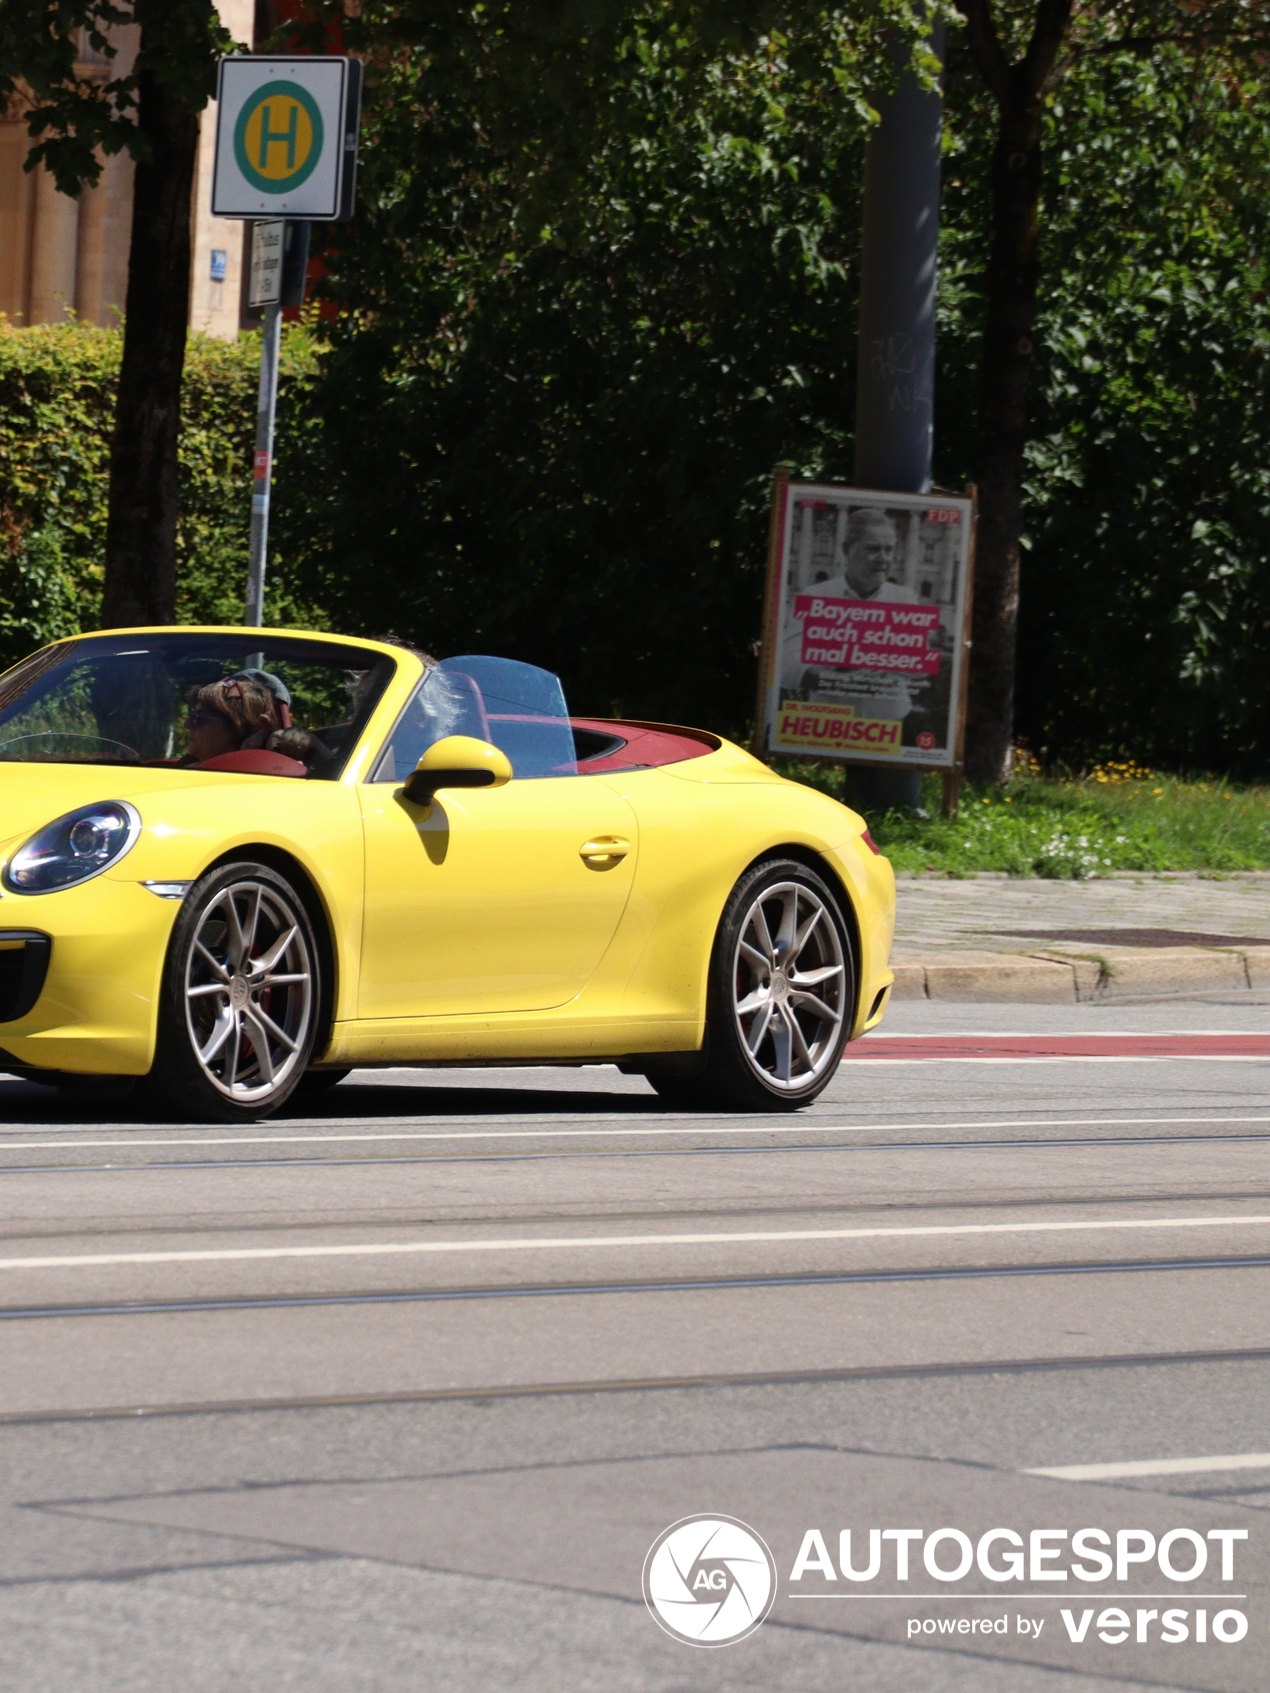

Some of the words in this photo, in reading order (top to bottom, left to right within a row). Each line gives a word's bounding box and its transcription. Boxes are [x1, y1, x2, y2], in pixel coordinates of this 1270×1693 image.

[258, 106, 298, 169] H
[927, 509, 959, 524] FDP
[892, 610, 937, 627] war
[806, 622, 858, 642] auch
[862, 625, 923, 648] schon
[805, 644, 847, 663] mal
[801, 704, 851, 715] WOLFGANG
[780, 715, 898, 744] HEUBISCH
[919, 736, 932, 746] 15
